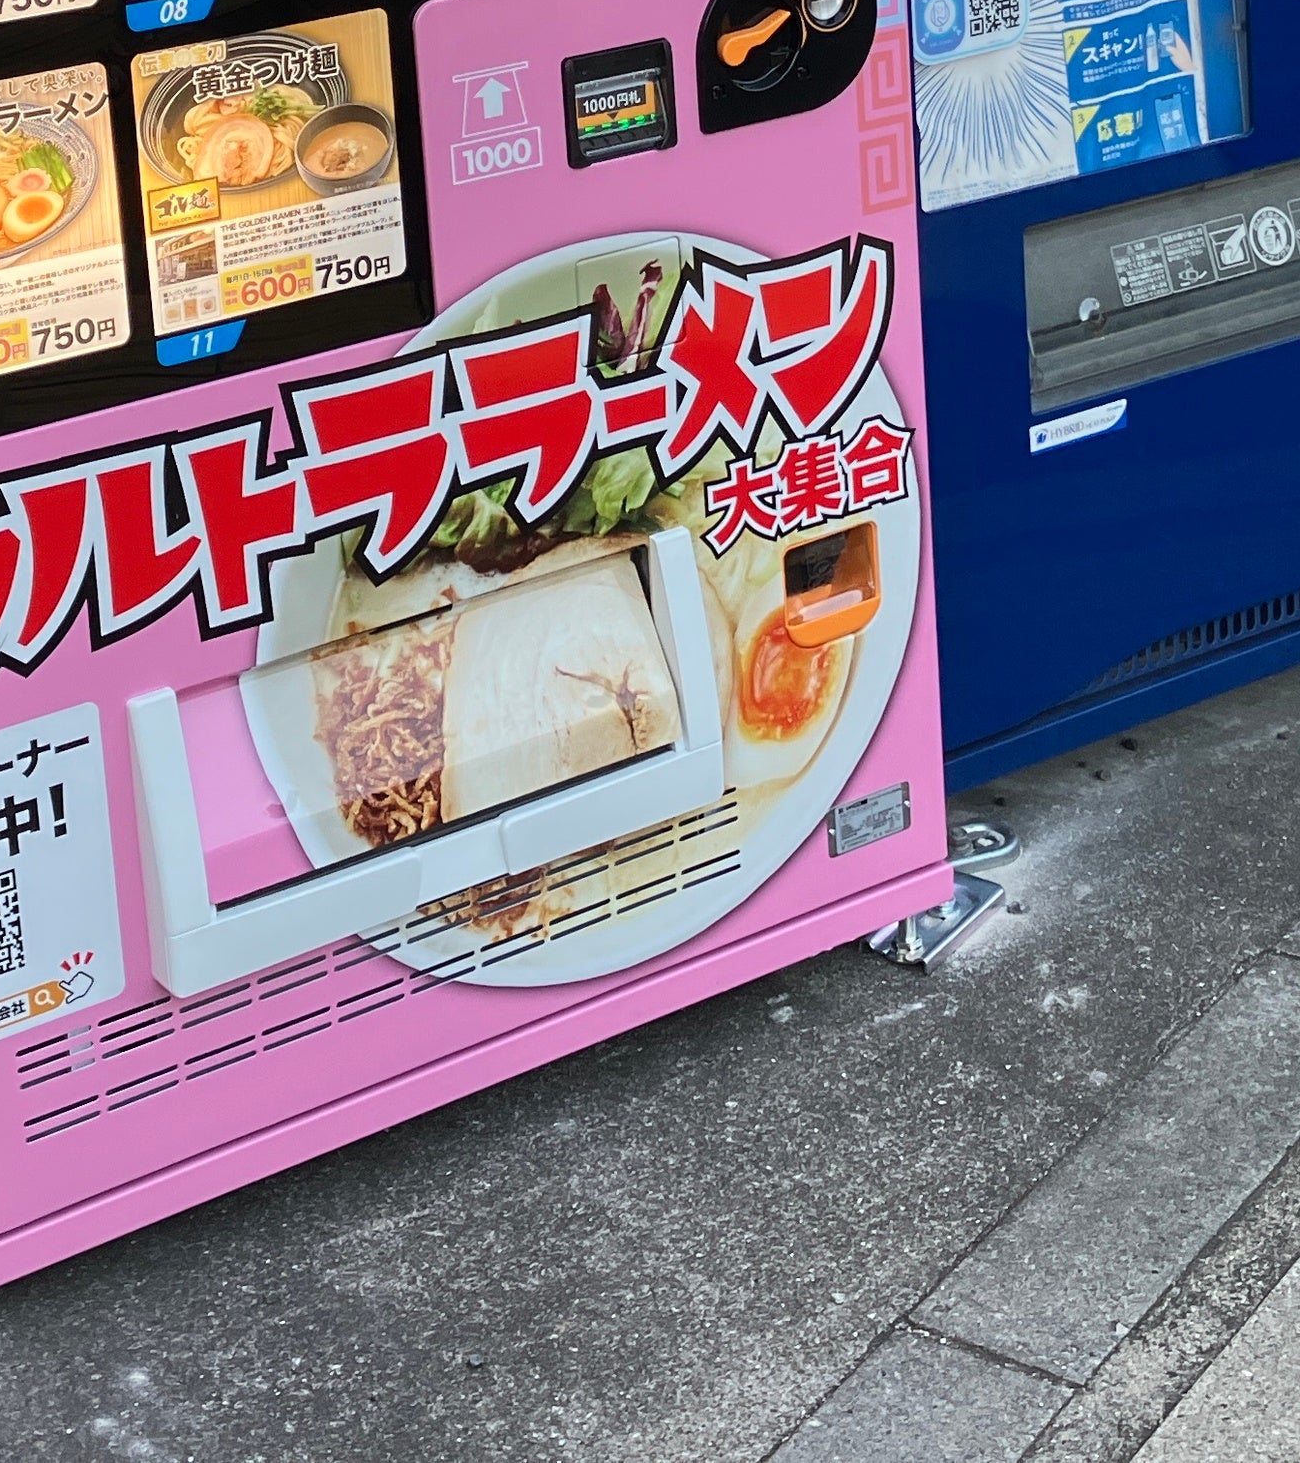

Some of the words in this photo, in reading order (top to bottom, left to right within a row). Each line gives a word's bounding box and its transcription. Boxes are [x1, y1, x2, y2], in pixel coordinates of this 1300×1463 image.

[1082, 34, 1143, 65] スキャン!
[193, 44, 340, 101] 黄金つけ麺
[582, 91, 641, 113] 1000円札
[462, 139, 531, 175] 1000
[241, 272, 311, 306] 600円
[316, 255, 391, 290] 750円
[32, 318, 116, 356] 750円
[190, 331, 213, 356] 11
[706, 417, 913, 557] 大集合
